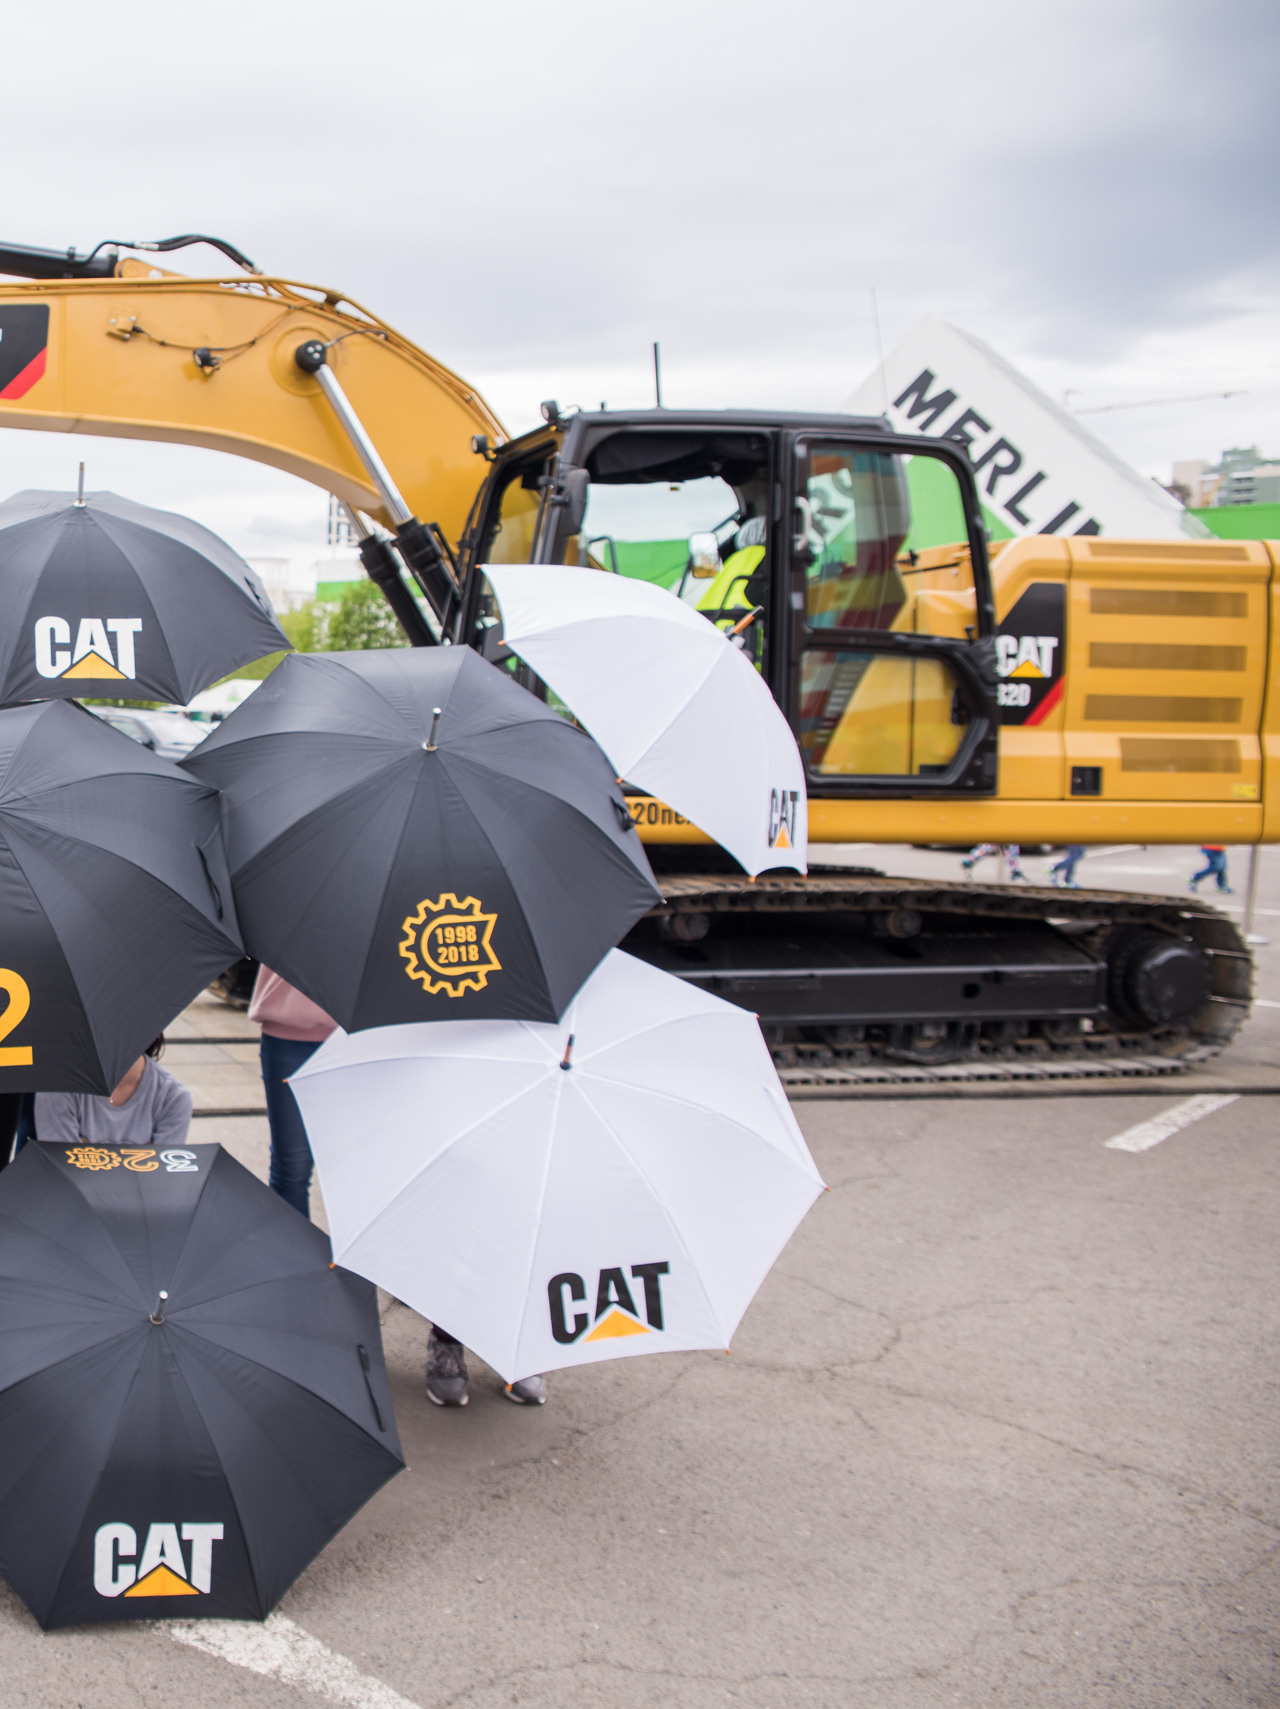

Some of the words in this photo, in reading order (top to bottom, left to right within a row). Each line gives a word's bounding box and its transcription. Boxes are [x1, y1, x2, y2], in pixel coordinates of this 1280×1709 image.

[892, 368, 1102, 536] MERLI
[34, 616, 143, 680] CAT
[994, 634, 1059, 678] CAT
[768, 787, 801, 849] CAT
[435, 925, 478, 945] 1998
[437, 944, 480, 964] 2018
[547, 1260, 671, 1345] CAT
[93, 1521, 225, 1598] CAT
